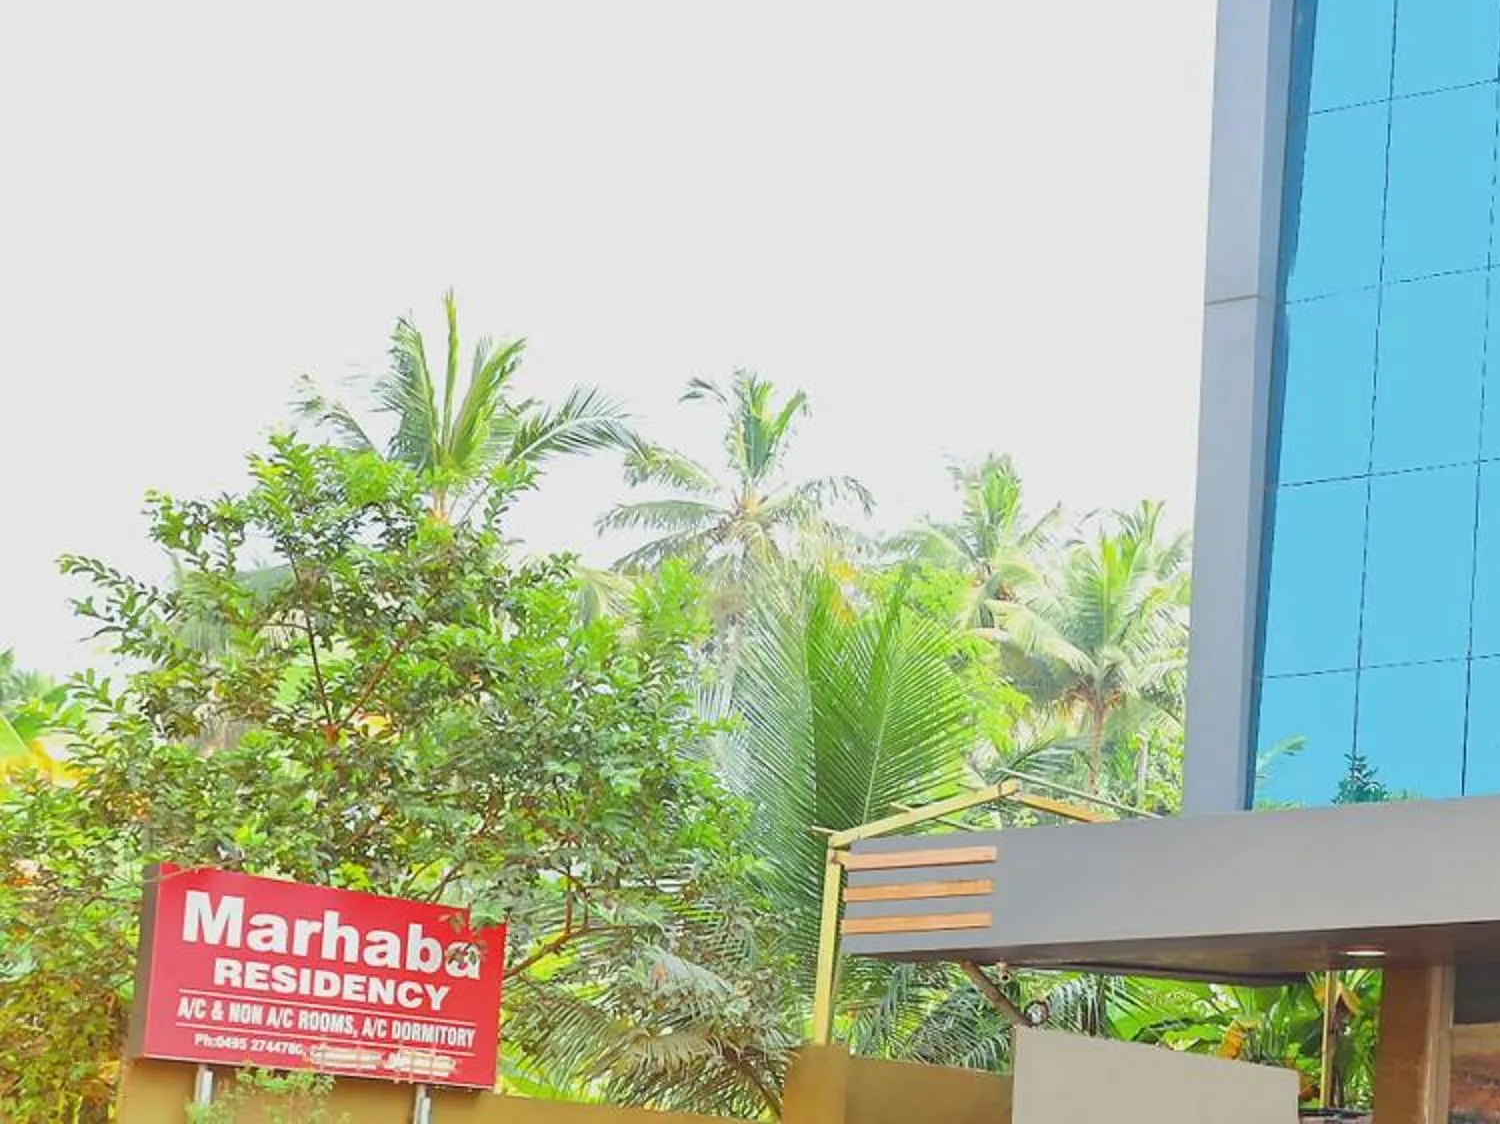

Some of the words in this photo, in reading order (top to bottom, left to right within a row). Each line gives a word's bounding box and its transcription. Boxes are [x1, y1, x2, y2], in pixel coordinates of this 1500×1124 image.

[181, 889, 482, 981] Marhaba
[213, 957, 449, 1011] RESIDENCY
[177, 996, 207, 1021] A/C
[211, 1000, 224, 1021] &
[228, 1002, 264, 1025] NON
[266, 1006, 293, 1029] A/C
[298, 1009, 358, 1038] ROOMS,
[362, 1016, 387, 1040] A/C
[391, 1019, 476, 1049] DORMITORY
